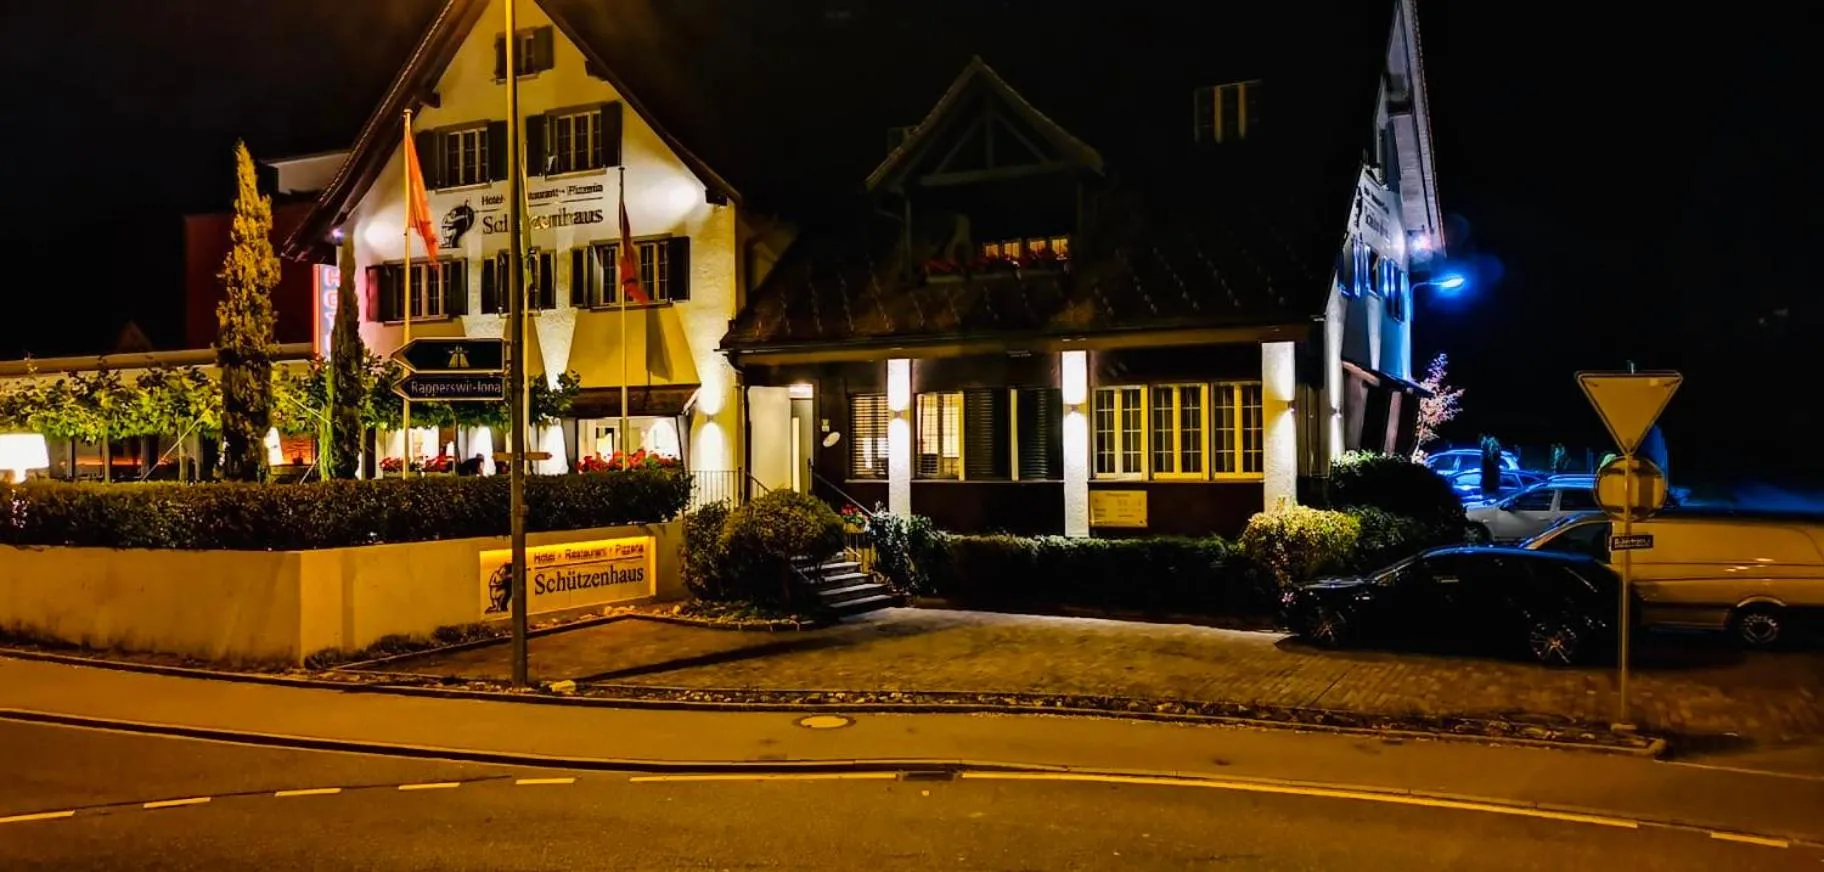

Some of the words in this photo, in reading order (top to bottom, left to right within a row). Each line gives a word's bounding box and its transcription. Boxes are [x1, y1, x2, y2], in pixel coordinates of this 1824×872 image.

[481, 194, 505, 206] Hotel
[534, 552, 557, 564] Hotel
[565, 547, 606, 560] Restaurant
[615, 544, 644, 555] Pizzeria
[534, 564, 644, 595] Schützenhaus
